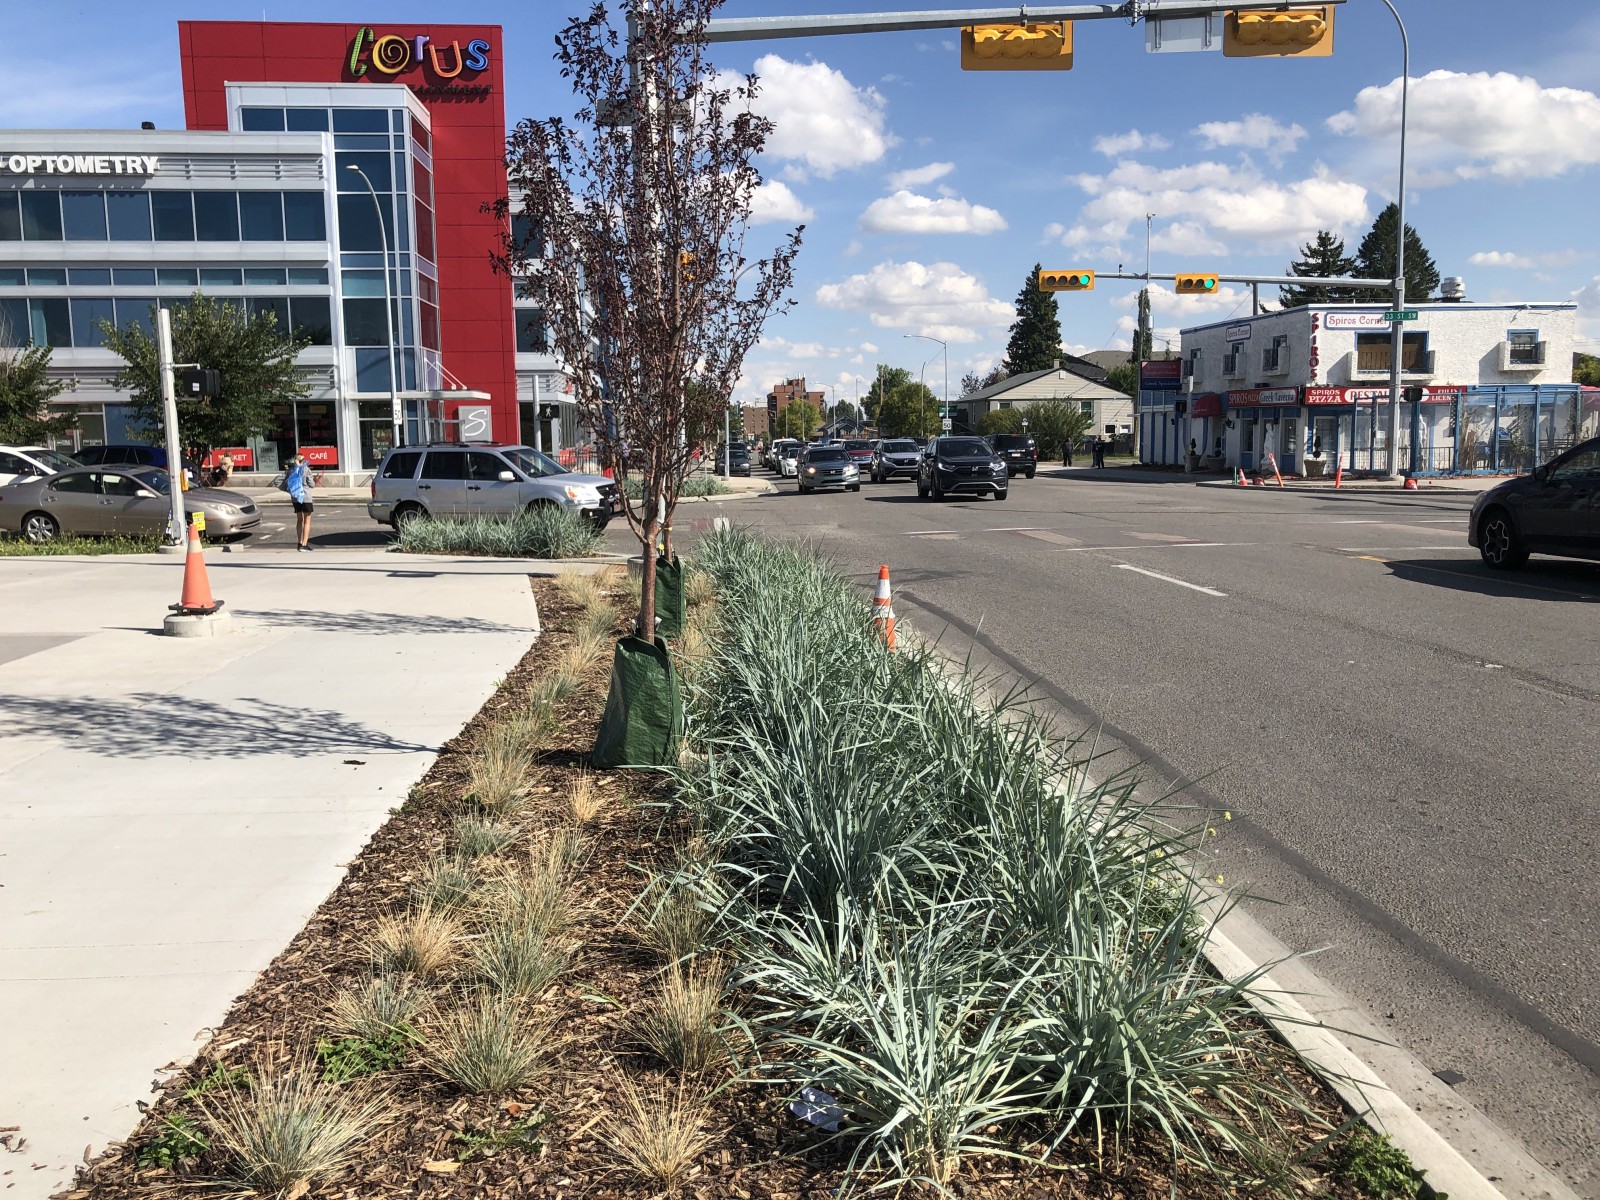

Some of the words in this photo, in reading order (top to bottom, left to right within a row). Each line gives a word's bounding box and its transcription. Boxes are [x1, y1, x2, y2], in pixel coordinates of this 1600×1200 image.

[8, 155, 159, 174] OPTOMETRY
[1328, 316, 1356, 327] Spiros
[1359, 316, 1387, 325] Corner
[1309, 313, 1320, 379] SPIROS
[1229, 393, 1248, 404] SPIROS
[1260, 392, 1273, 402] Greek
[1308, 395, 1342, 403] PIZZA
[309, 451, 328, 460] CAFÉ
